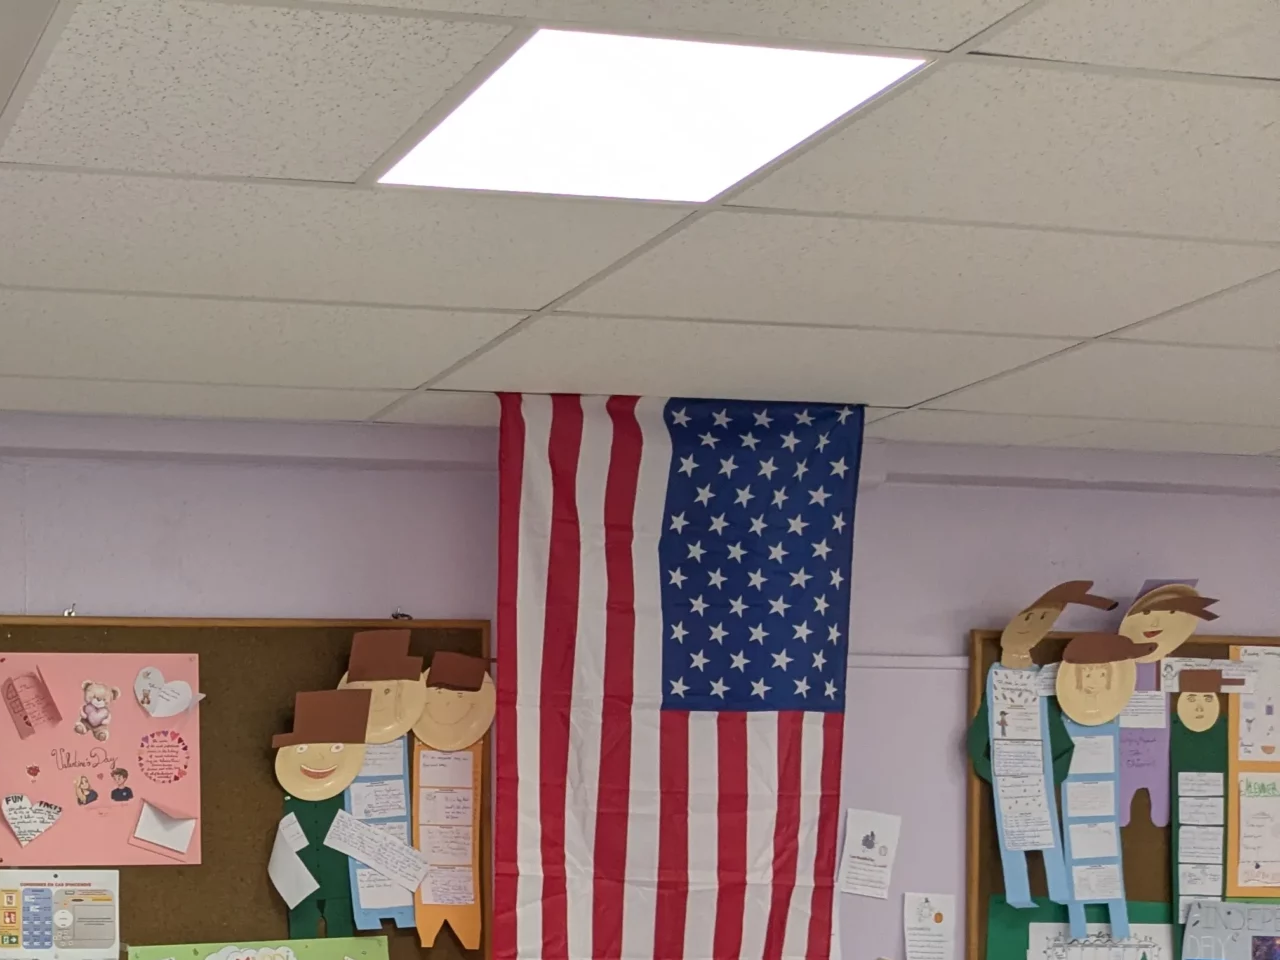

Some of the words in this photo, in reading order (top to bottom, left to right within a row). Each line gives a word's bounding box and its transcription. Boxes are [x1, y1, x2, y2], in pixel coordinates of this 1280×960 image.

[51, 747, 92, 770] Valentine's
[89, 746, 119, 770] Day
[4, 794, 24, 806] FUN
